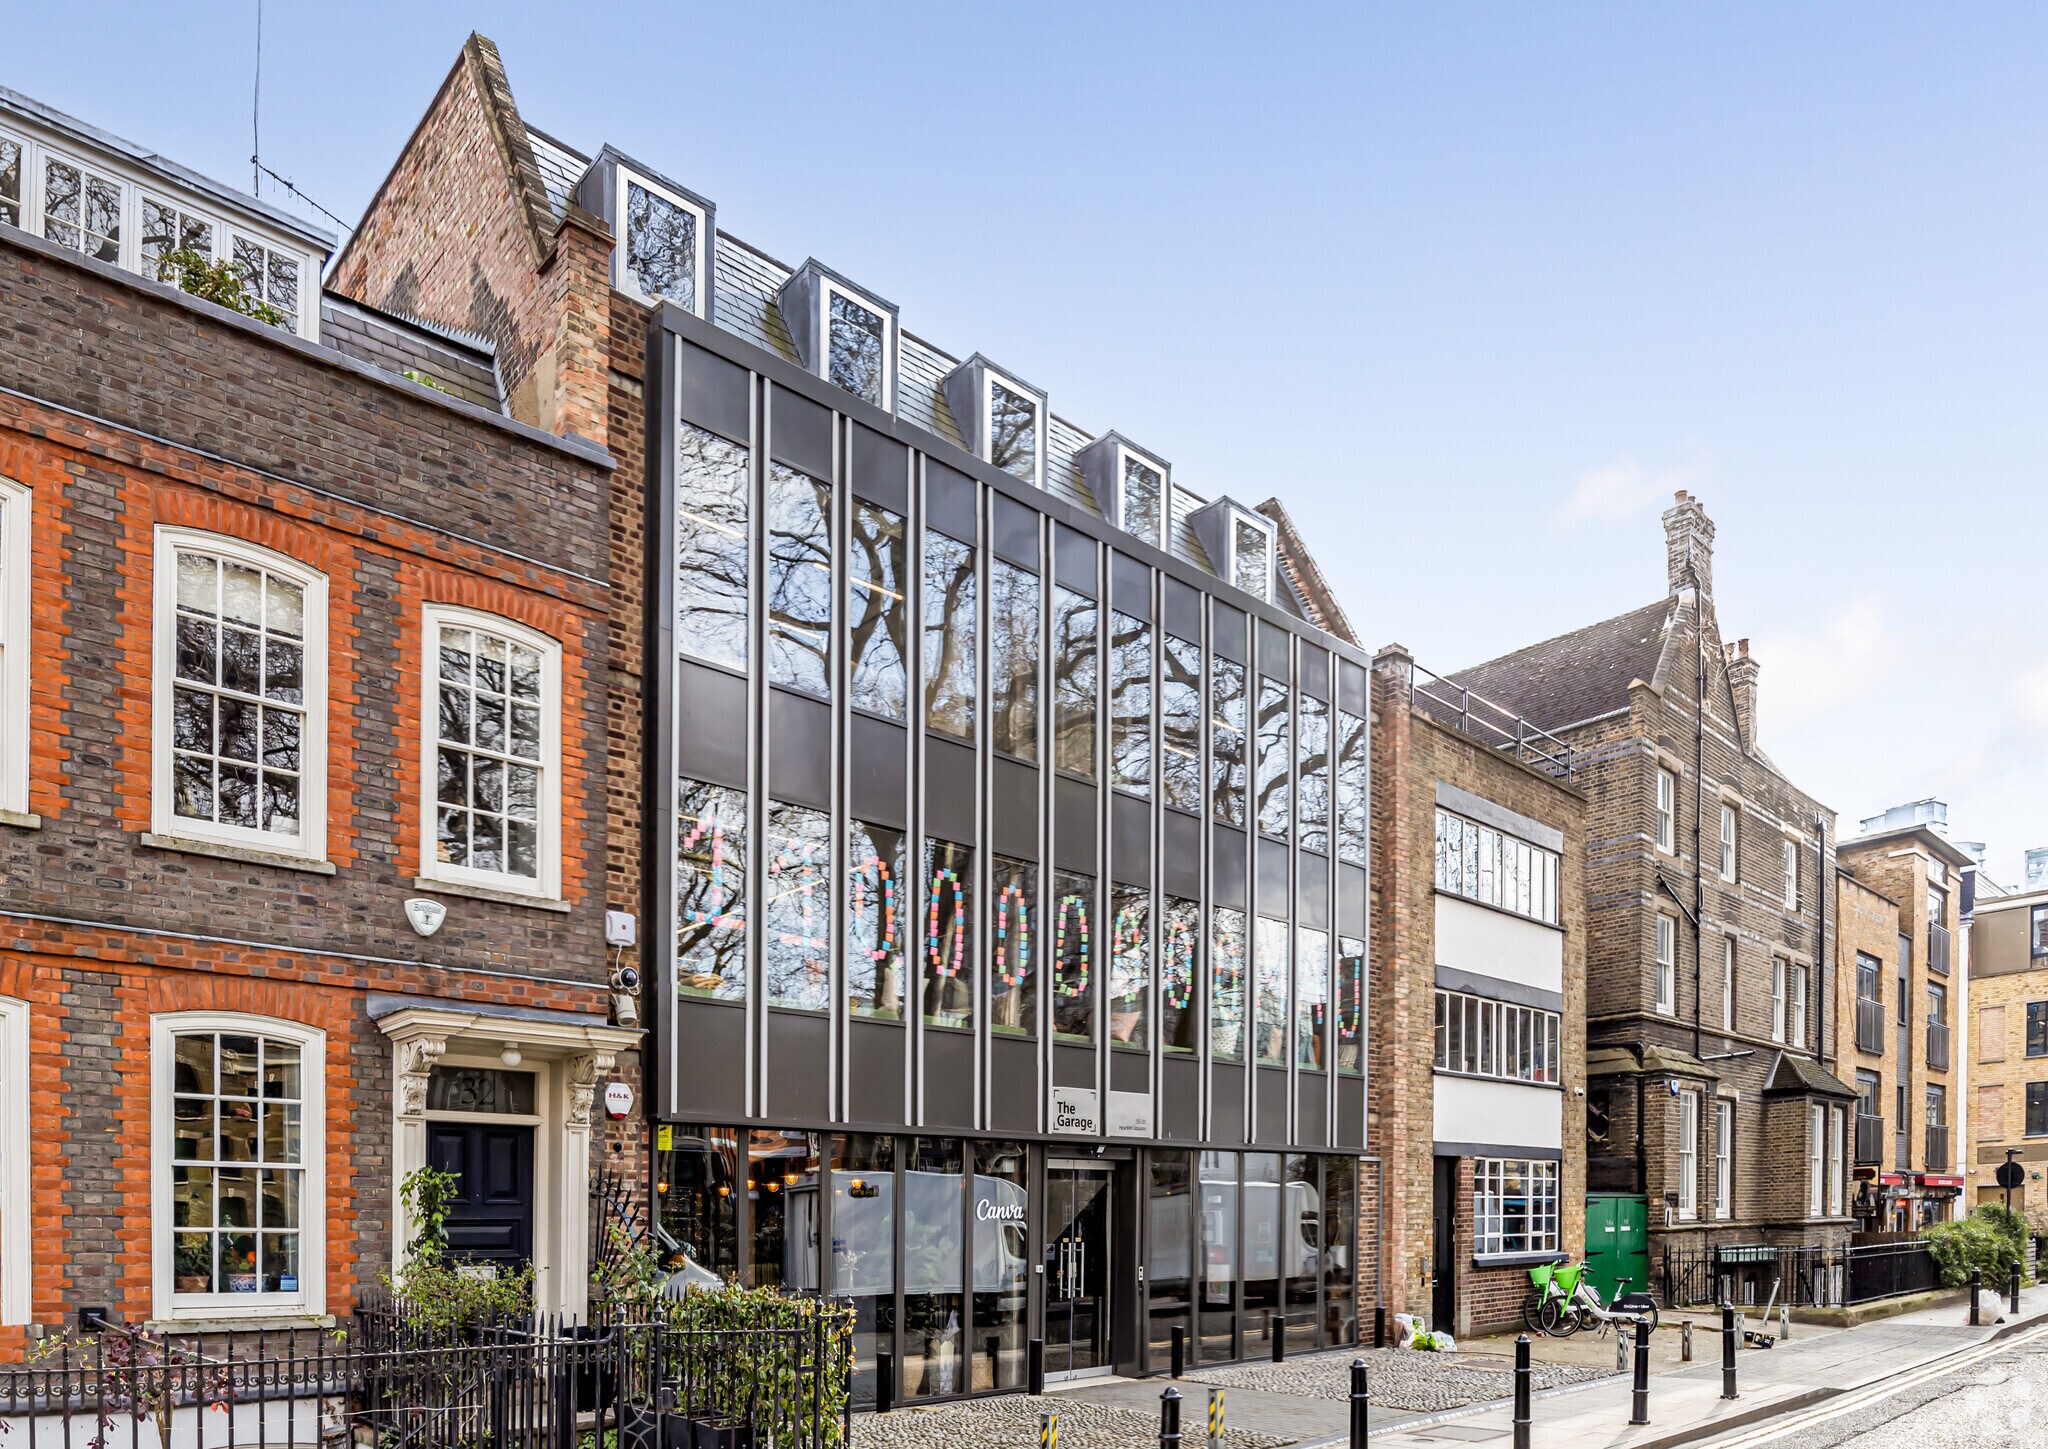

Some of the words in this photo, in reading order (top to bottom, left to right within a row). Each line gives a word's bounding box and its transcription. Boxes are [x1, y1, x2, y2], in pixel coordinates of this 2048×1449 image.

[461, 1077, 493, 1105] 32
[1057, 1101, 1076, 1115] The
[1057, 1115, 1093, 1131] Garage
[976, 1198, 1024, 1221] Canva
